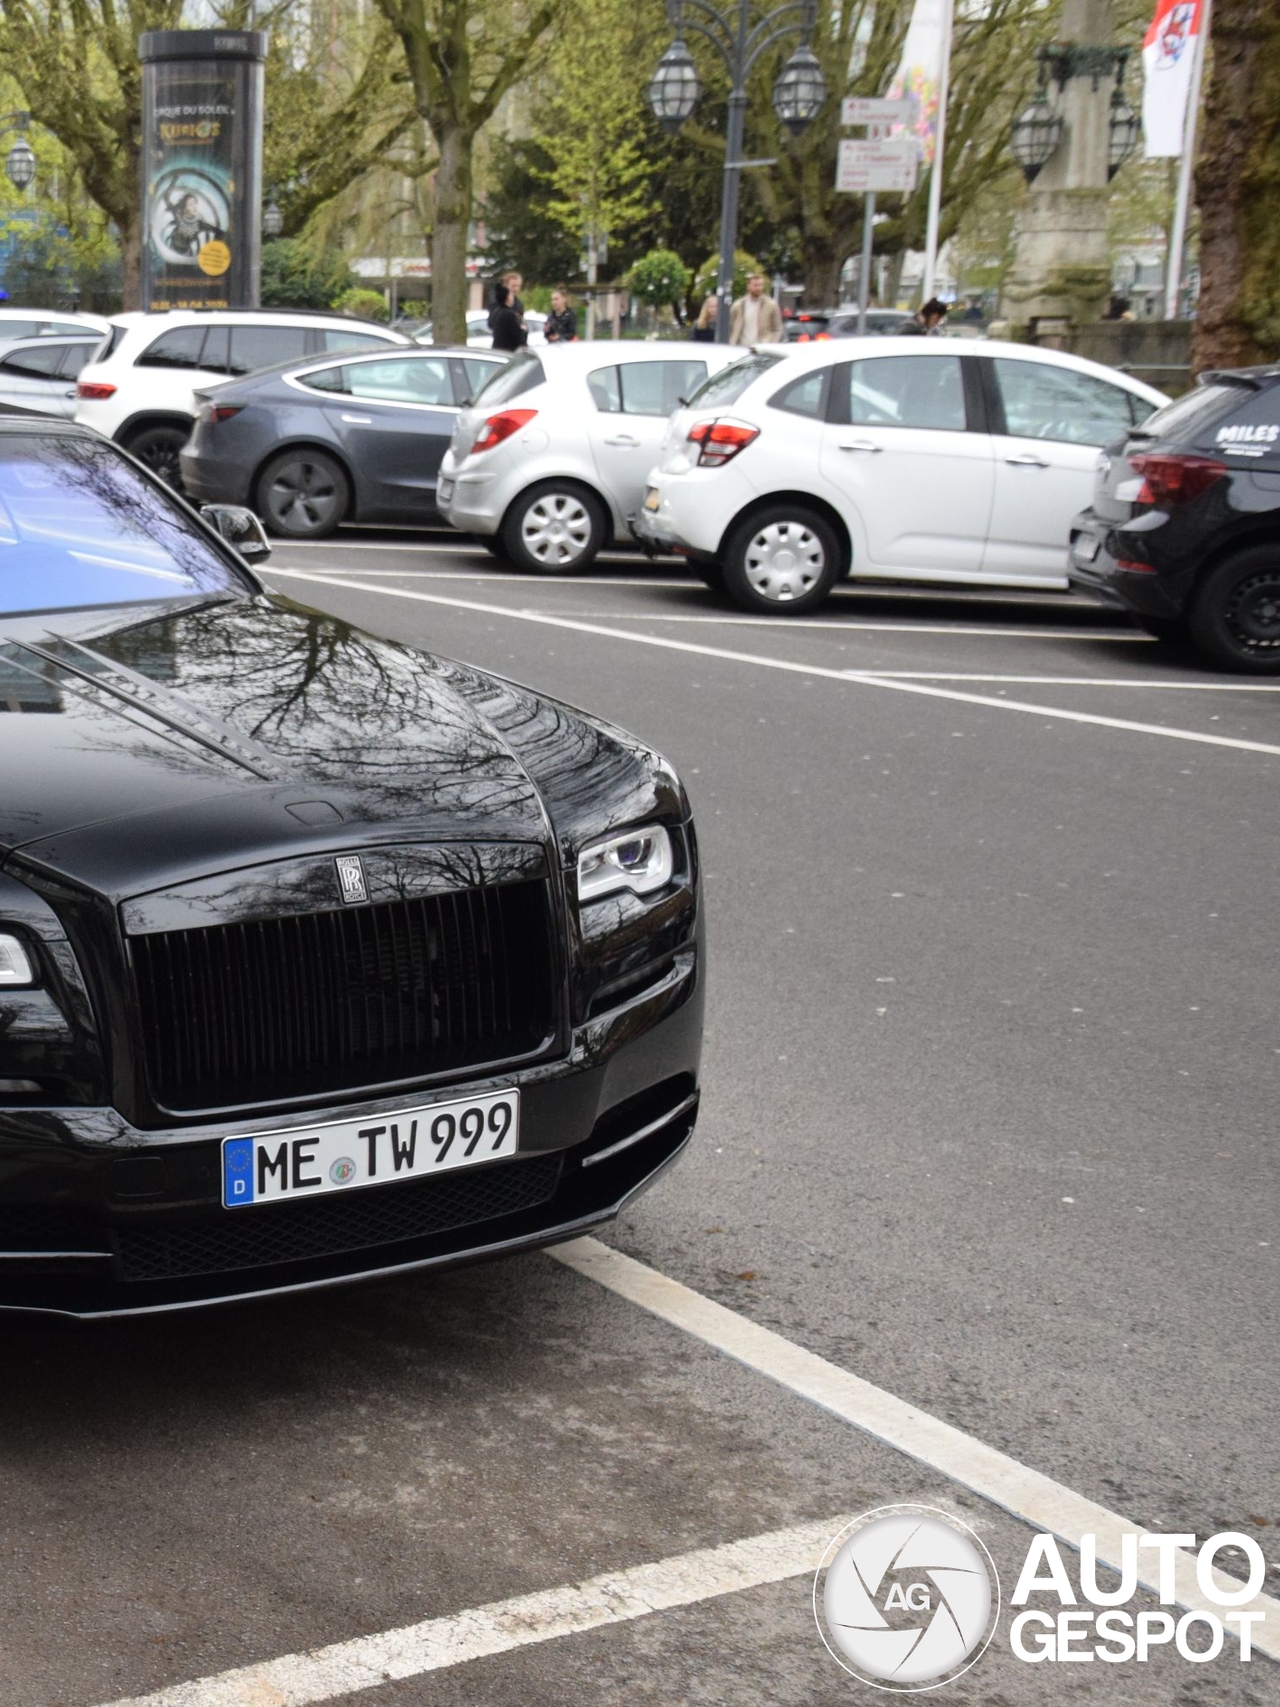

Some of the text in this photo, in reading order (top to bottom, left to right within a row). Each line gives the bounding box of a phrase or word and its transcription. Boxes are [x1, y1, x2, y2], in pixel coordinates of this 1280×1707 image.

[183, 106, 197, 115] DU
[198, 105, 229, 115] SOLEIL
[1215, 425, 1279, 443] MILES
[257, 1101, 512, 1194] ME TW 999
[233, 1179, 246, 1195] D
